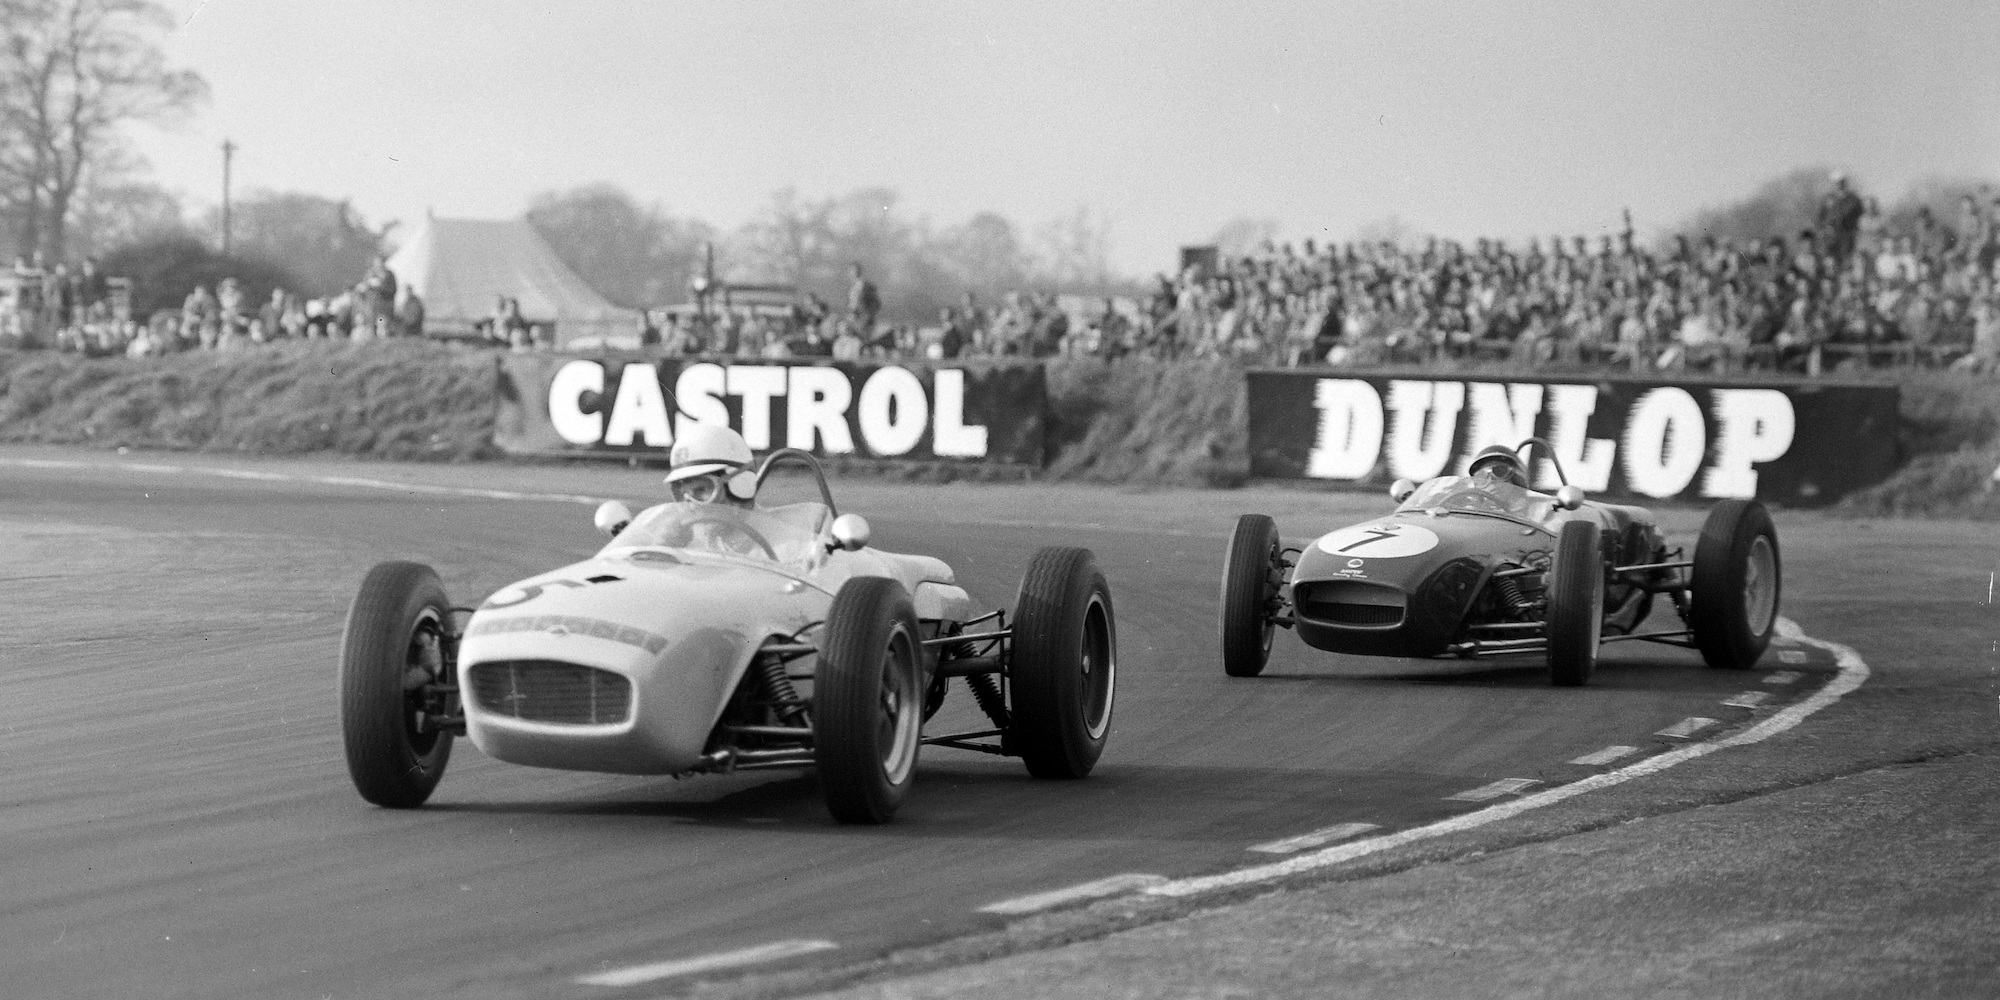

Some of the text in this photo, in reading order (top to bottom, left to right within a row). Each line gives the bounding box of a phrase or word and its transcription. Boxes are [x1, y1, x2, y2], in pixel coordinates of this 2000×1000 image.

[548, 360, 988, 457] CASTROL
[1307, 378, 1797, 499] DUNLOP
[1338, 530, 1400, 553] 7
